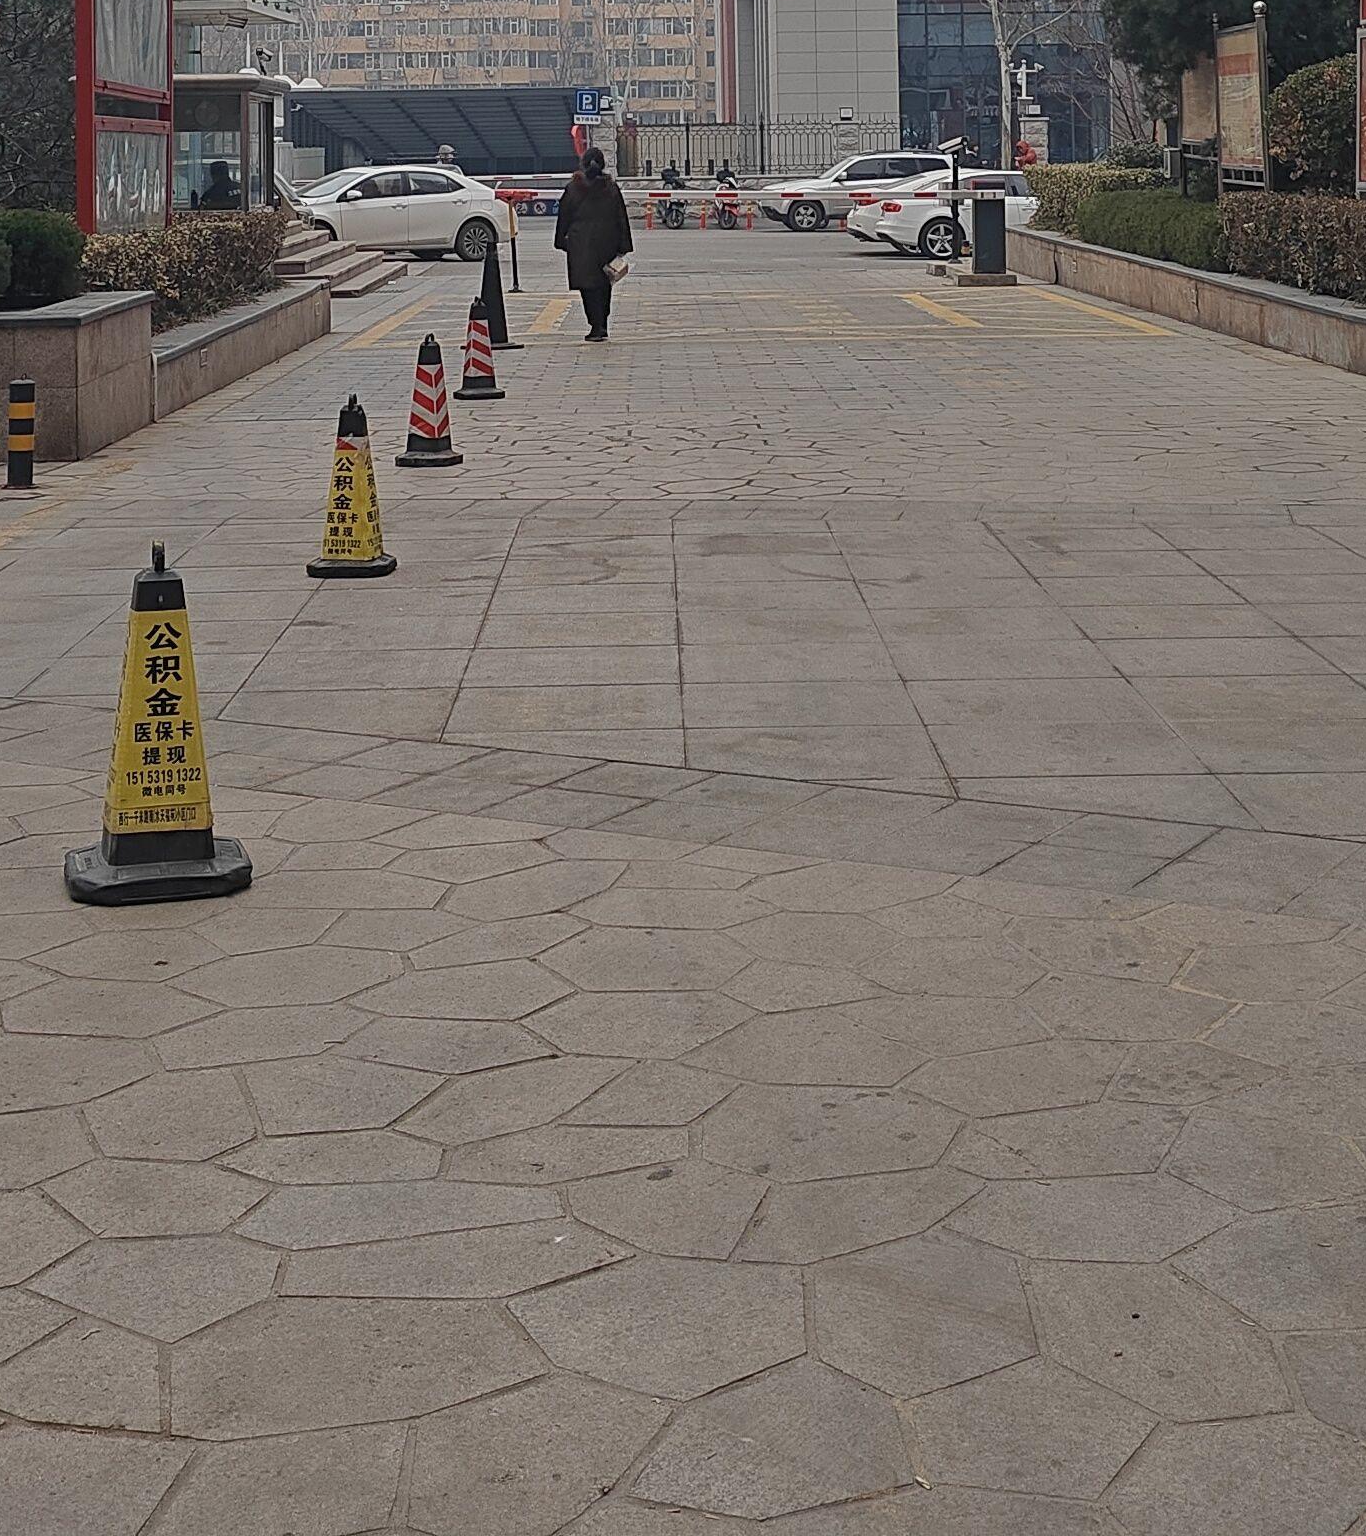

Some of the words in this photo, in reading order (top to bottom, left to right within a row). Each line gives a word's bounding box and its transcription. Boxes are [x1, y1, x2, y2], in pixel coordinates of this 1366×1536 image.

[333, 456, 355, 510] 公积金
[326, 511, 358, 524] 医保卡
[329, 526, 353, 538] 提现
[144, 621, 183, 718] 公积金
[134, 720, 194, 743] 医保卡
[141, 745, 187, 766] 提现
[141, 783, 187, 797] 微电同号
